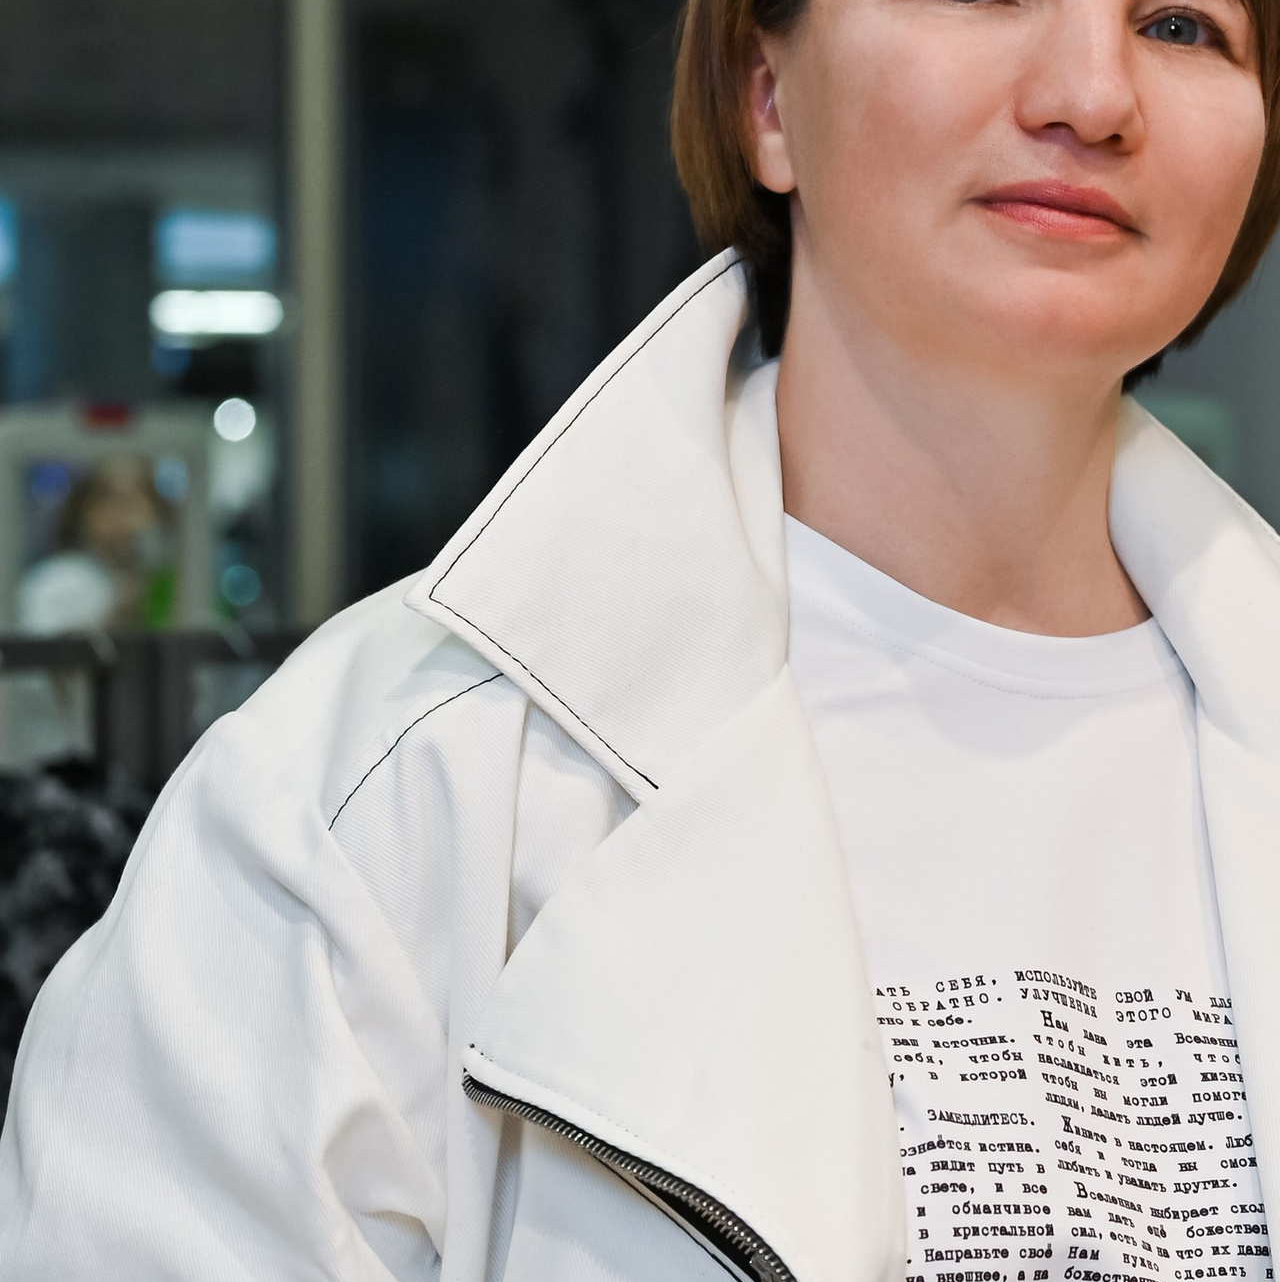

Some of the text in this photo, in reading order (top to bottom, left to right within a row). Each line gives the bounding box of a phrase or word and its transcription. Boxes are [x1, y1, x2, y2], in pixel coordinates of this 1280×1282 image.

[936, 975, 996, 992] СЕБЯ,
[1014, 970, 1232, 1009] ИСПОЛЬЗУЙТЕ СВОЙ УМ ДЛЯ
[893, 993, 1002, 1011] ОБРАТНО.
[1020, 985, 1233, 1025] УЛУЧШЕНИЯ ЭТОГО МИРА
[928, 1014, 972, 1027] себе.
[1040, 1010, 1153, 1048] Нам дана эта
[891, 1035, 1015, 1048] ваш источник.
[894, 1049, 1023, 1065] себя, чтобы
[1102, 1055, 1162, 1068] жить,
[928, 1068, 1027, 1081] в которой
[1038, 1053, 1178, 1088] наслаждаться этой
[1045, 1092, 1242, 1127] людям, делать людей лучше.
[1123, 1096, 1168, 1107] могли
[927, 1109, 1035, 1126] ЗАМЕДЛИТЕСЬ.
[1061, 1115, 1107, 1143] Живите
[1114, 1137, 1122, 1147] в
[1128, 1141, 1213, 1153] настоящем.
[978, 1143, 1040, 1153] истина.
[1055, 1140, 1082, 1155] себя
[1097, 1151, 1105, 1160] и
[1121, 1157, 1157, 1172] тогда
[930, 1160, 1045, 1175] видит путь в
[1058, 1159, 1237, 1194] любить и уважать других.
[921, 1183, 1047, 1194] свете, и все
[917, 1200, 1051, 1217] и обманчивое
[1074, 1181, 1218, 1222] Вселенная выбирает
[1067, 1207, 1092, 1218] вам
[1108, 1212, 1135, 1228] дать
[918, 1224, 1054, 1240] в кристальной
[1071, 1227, 1102, 1240] сил,
[1110, 1232, 1137, 1246] есть
[1156, 1246, 1170, 1258] на
[1176, 1248, 1203, 1260] что
[1211, 1245, 1231, 1255] их
[924, 1243, 1053, 1263] Направьте своё
[1068, 1246, 1246, 1280] Нам нужно сделать
[1017, 1270, 1025, 1281] а
[1033, 1270, 1049, 1281] на
